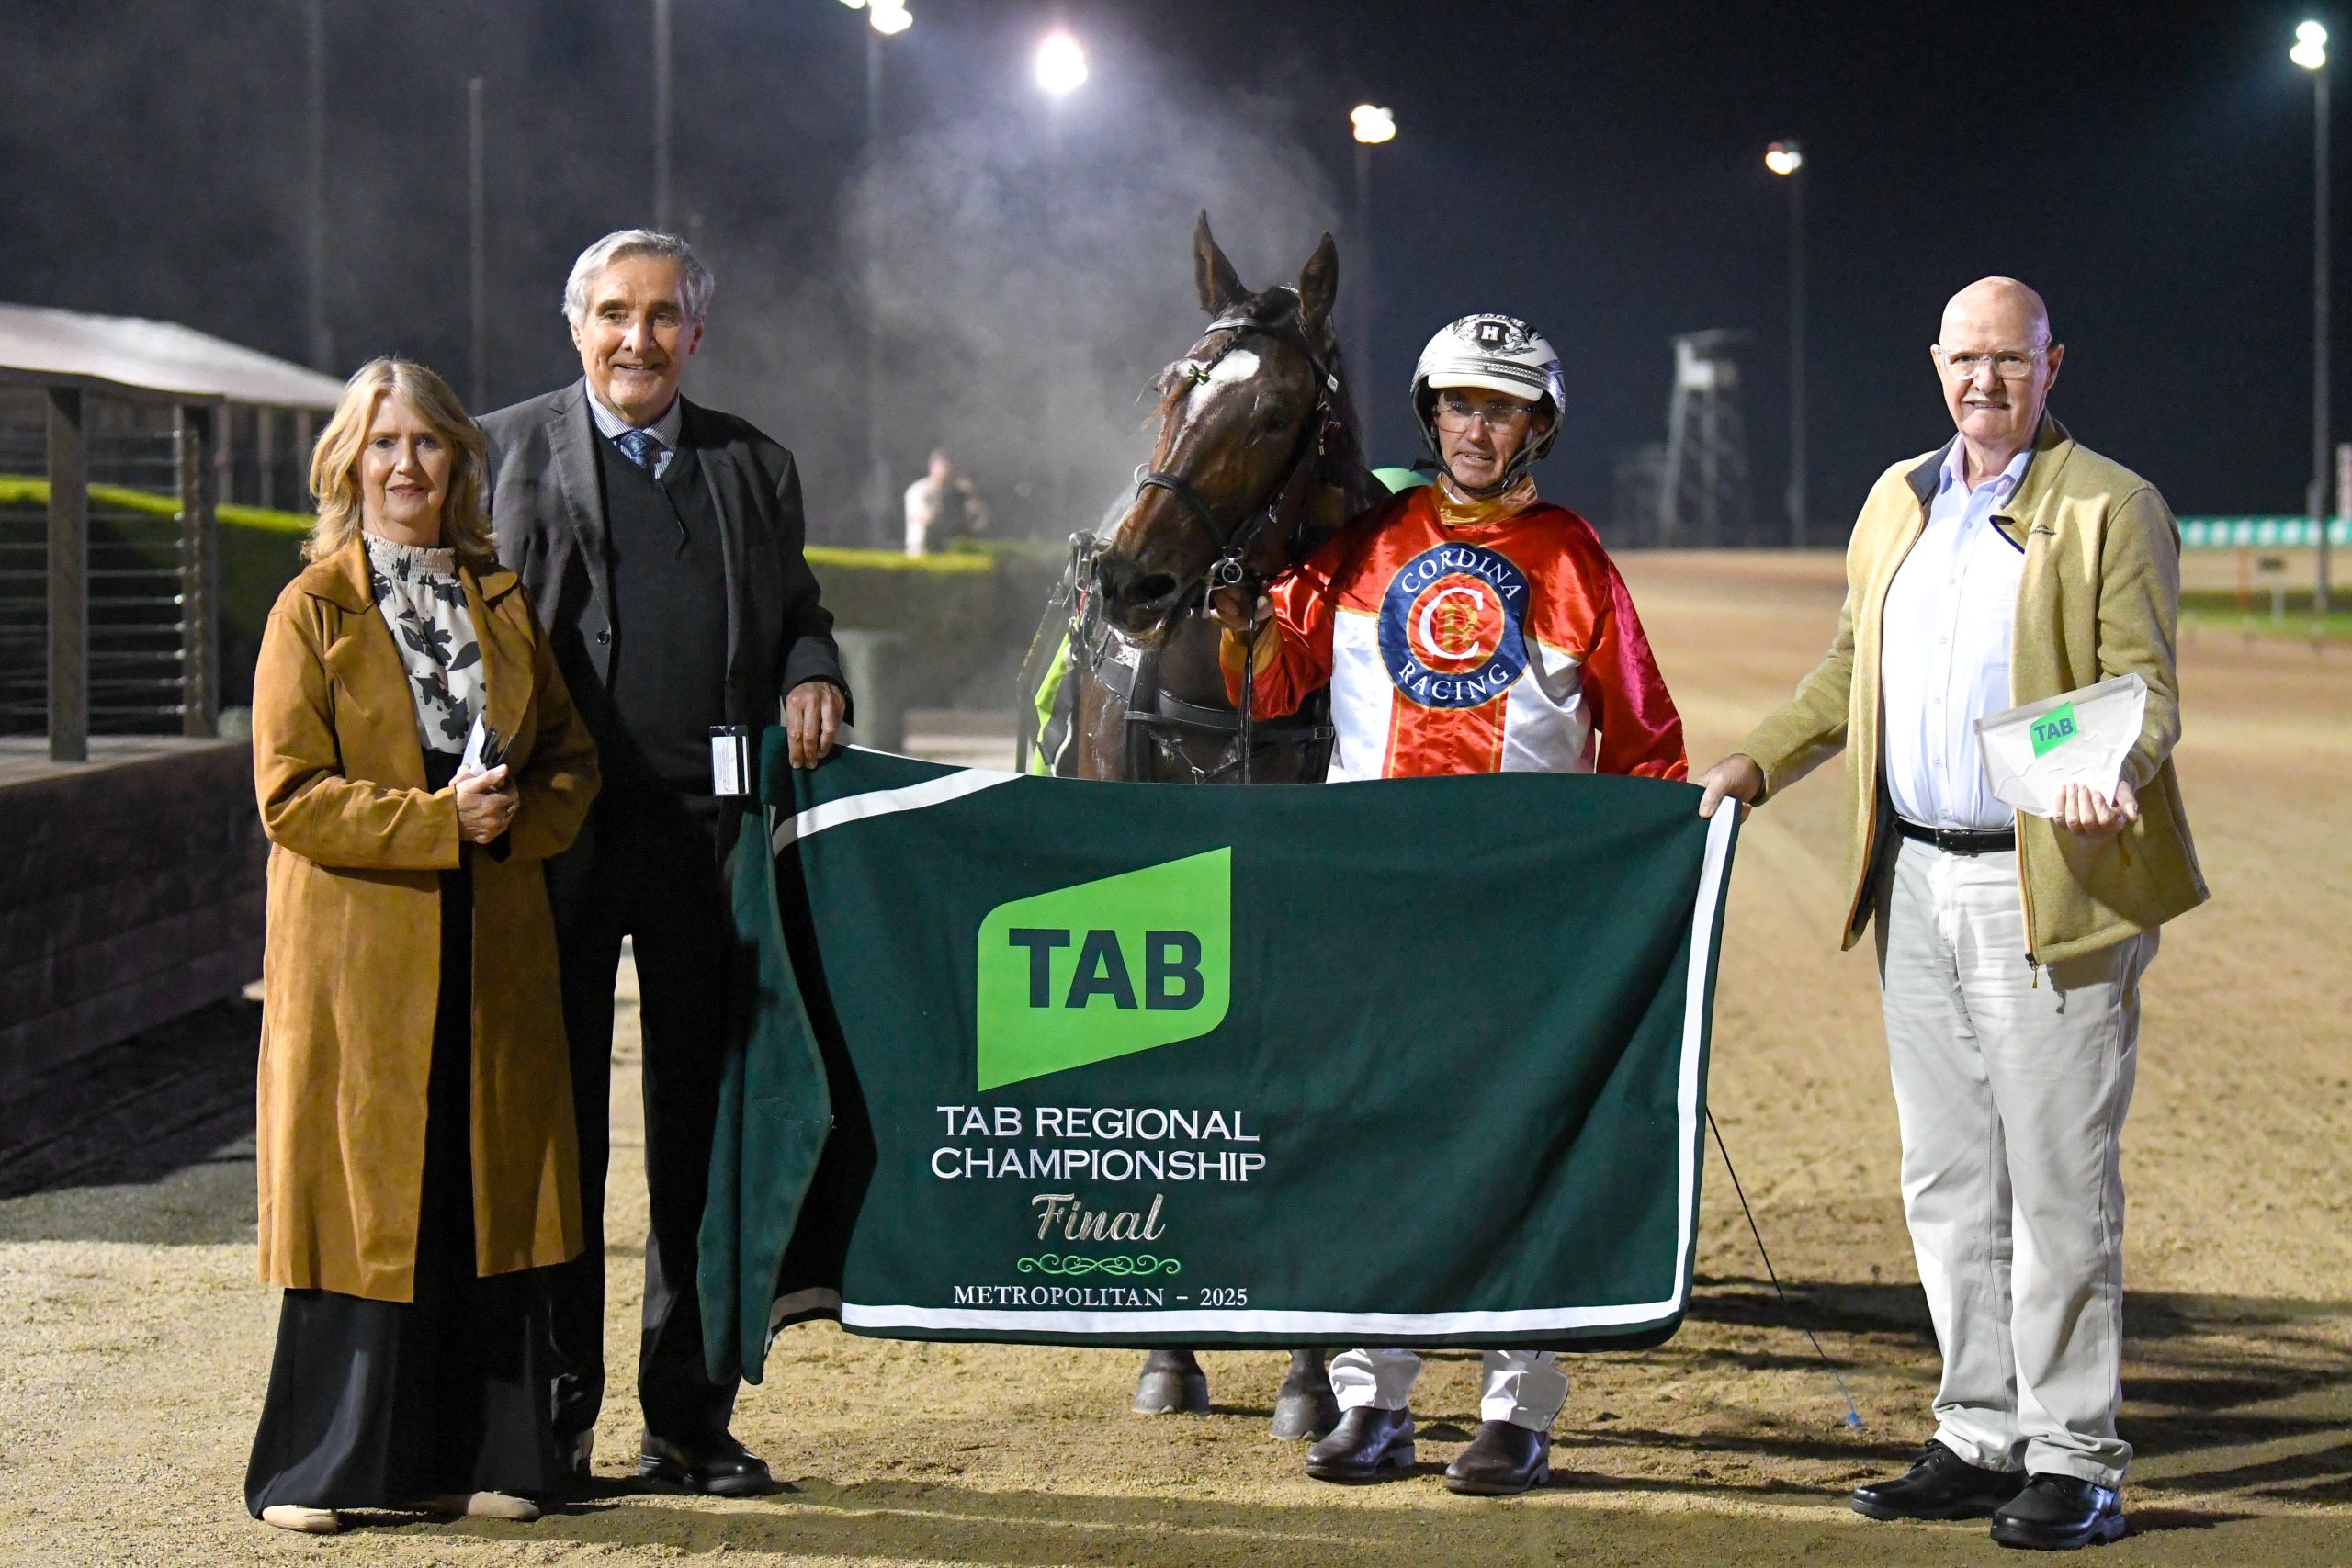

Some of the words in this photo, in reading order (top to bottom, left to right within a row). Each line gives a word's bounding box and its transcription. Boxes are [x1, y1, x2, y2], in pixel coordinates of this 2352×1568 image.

[1401, 547, 1521, 601] CORDINA
[1419, 586, 1483, 660] C
[1398, 660, 1509, 701] RACING
[2033, 717, 2074, 742] TAB
[1008, 927, 1204, 1010] TAB
[936, 1104, 1023, 1137] TAB
[1035, 1106, 1261, 1142] REGIONAL
[931, 1146, 1267, 1182] CHAMPIONSHIP
[1031, 1192, 1166, 1242] Final
[953, 1285, 1164, 1307] METROPOLITAN
[1199, 1287, 1249, 1307] 2025
